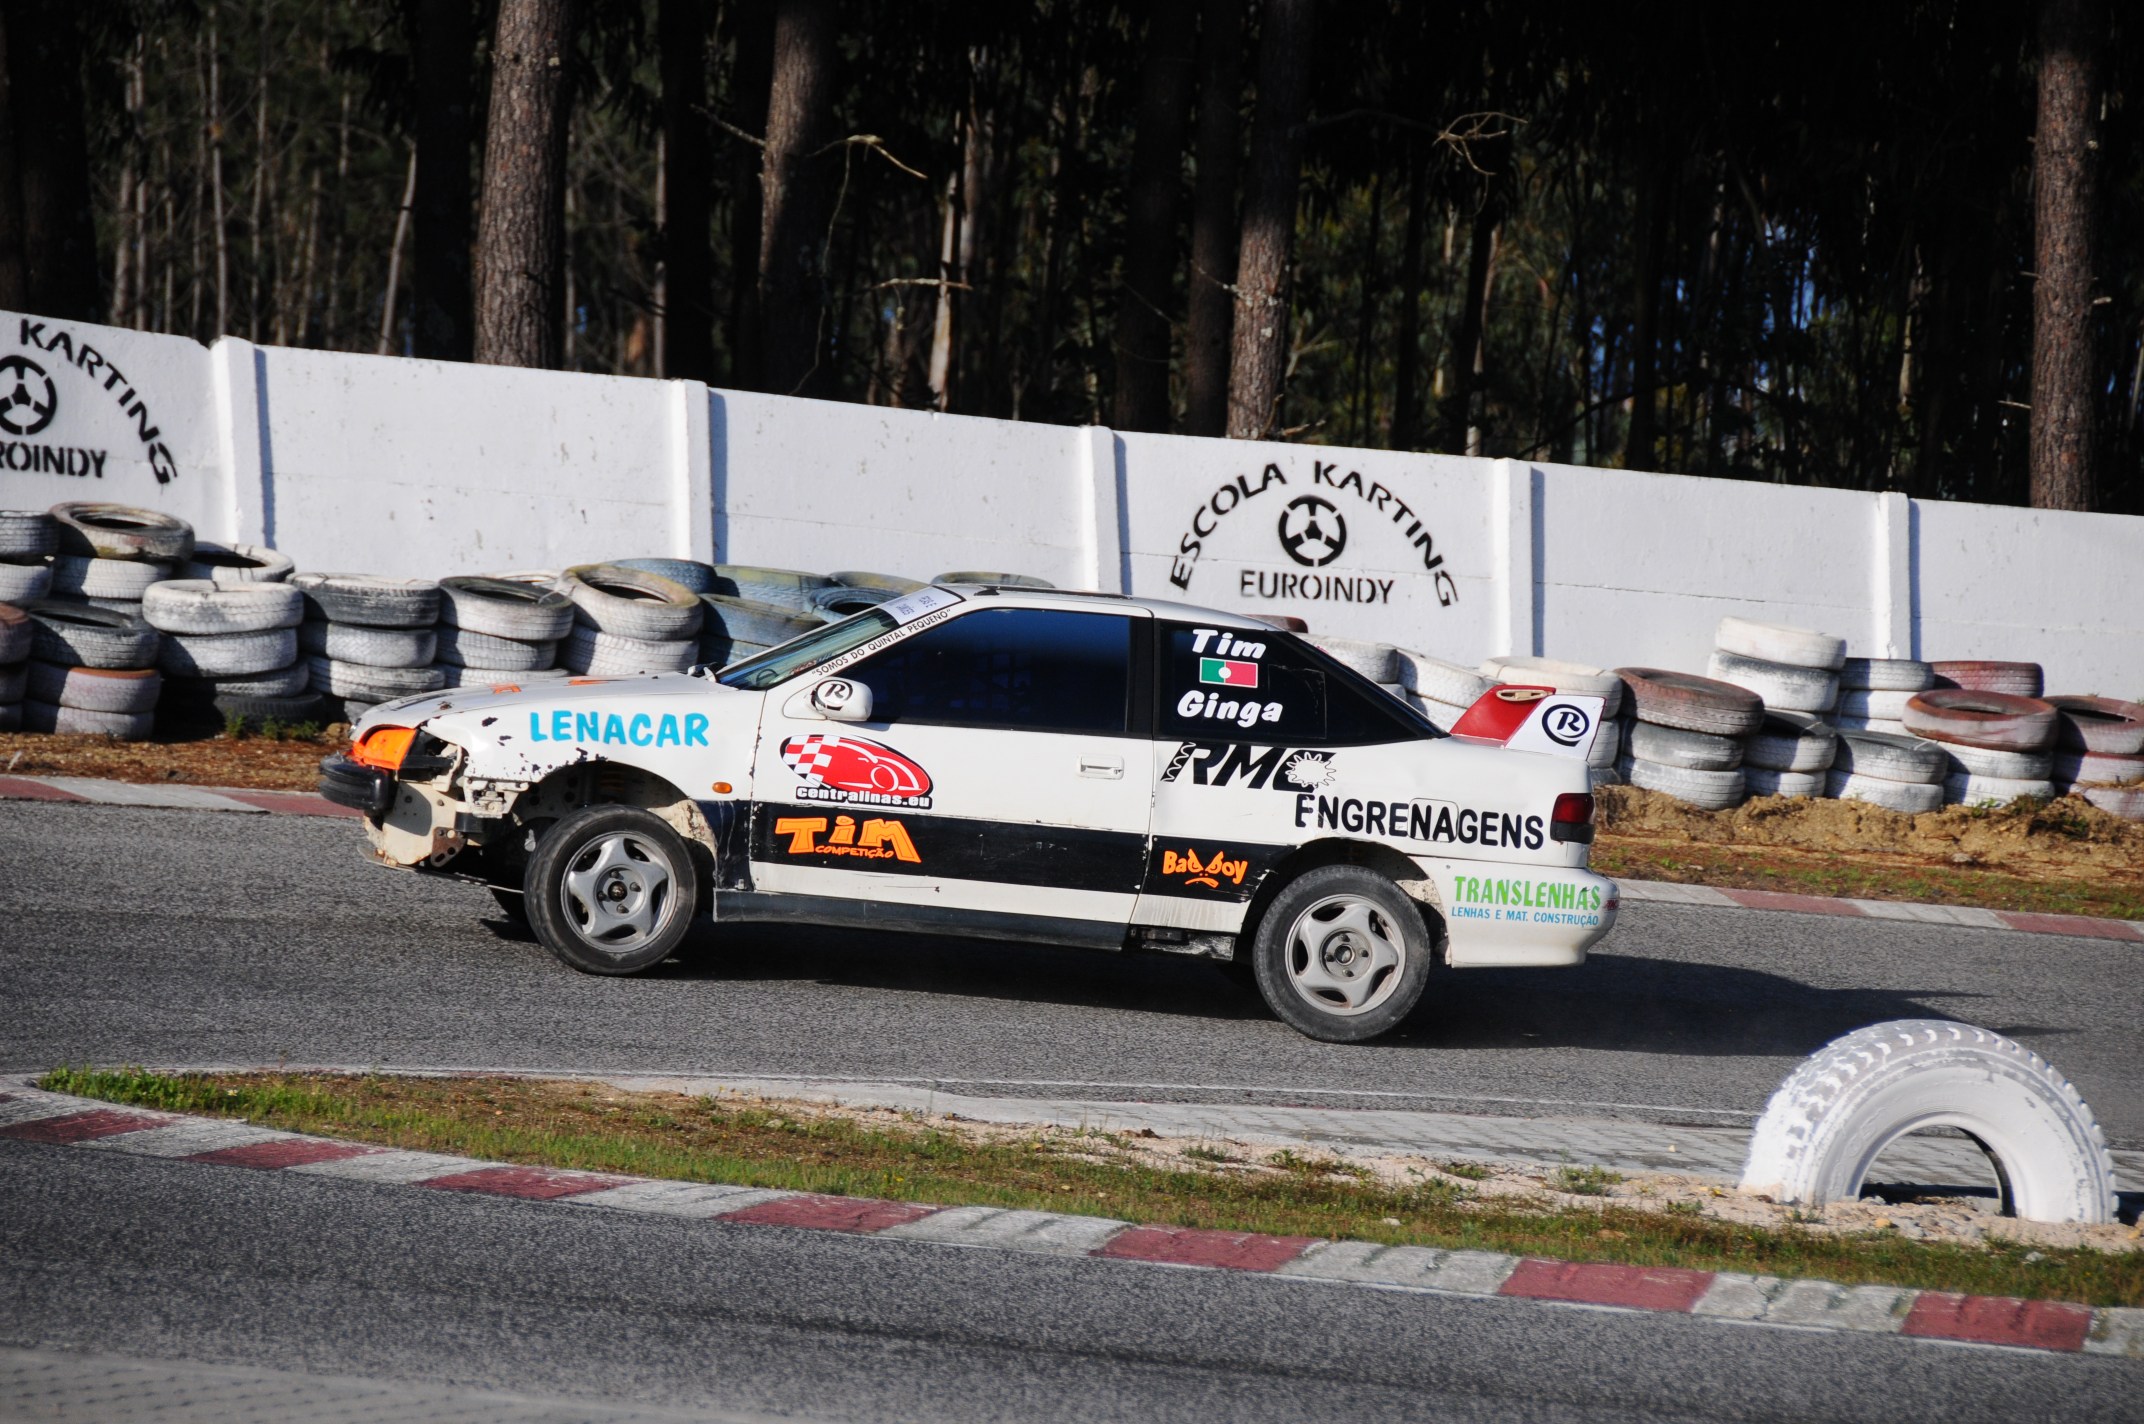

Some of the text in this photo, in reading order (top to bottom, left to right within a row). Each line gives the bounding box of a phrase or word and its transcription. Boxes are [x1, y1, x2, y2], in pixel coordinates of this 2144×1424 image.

[21, 318, 178, 485] KARTING
[0, 441, 107, 478] OINDY
[1170, 460, 1459, 608] ESCOLA KARTING
[1240, 570, 1394, 603] EUROINDY
[850, 648, 865, 660] DO
[868, 630, 906, 651] QUINTAL
[1192, 629, 1266, 659] Tim
[1177, 690, 1283, 728] Ginga
[530, 711, 709, 747] LENACAR
[796, 787, 930, 808] centralinas.eu
[1295, 793, 1544, 850] ENGRENAGENS
[1454, 876, 1600, 911] TRANSLENHAS
[1451, 906, 1599, 928] LENHAS E MAT. CONSTRUÇÃO
